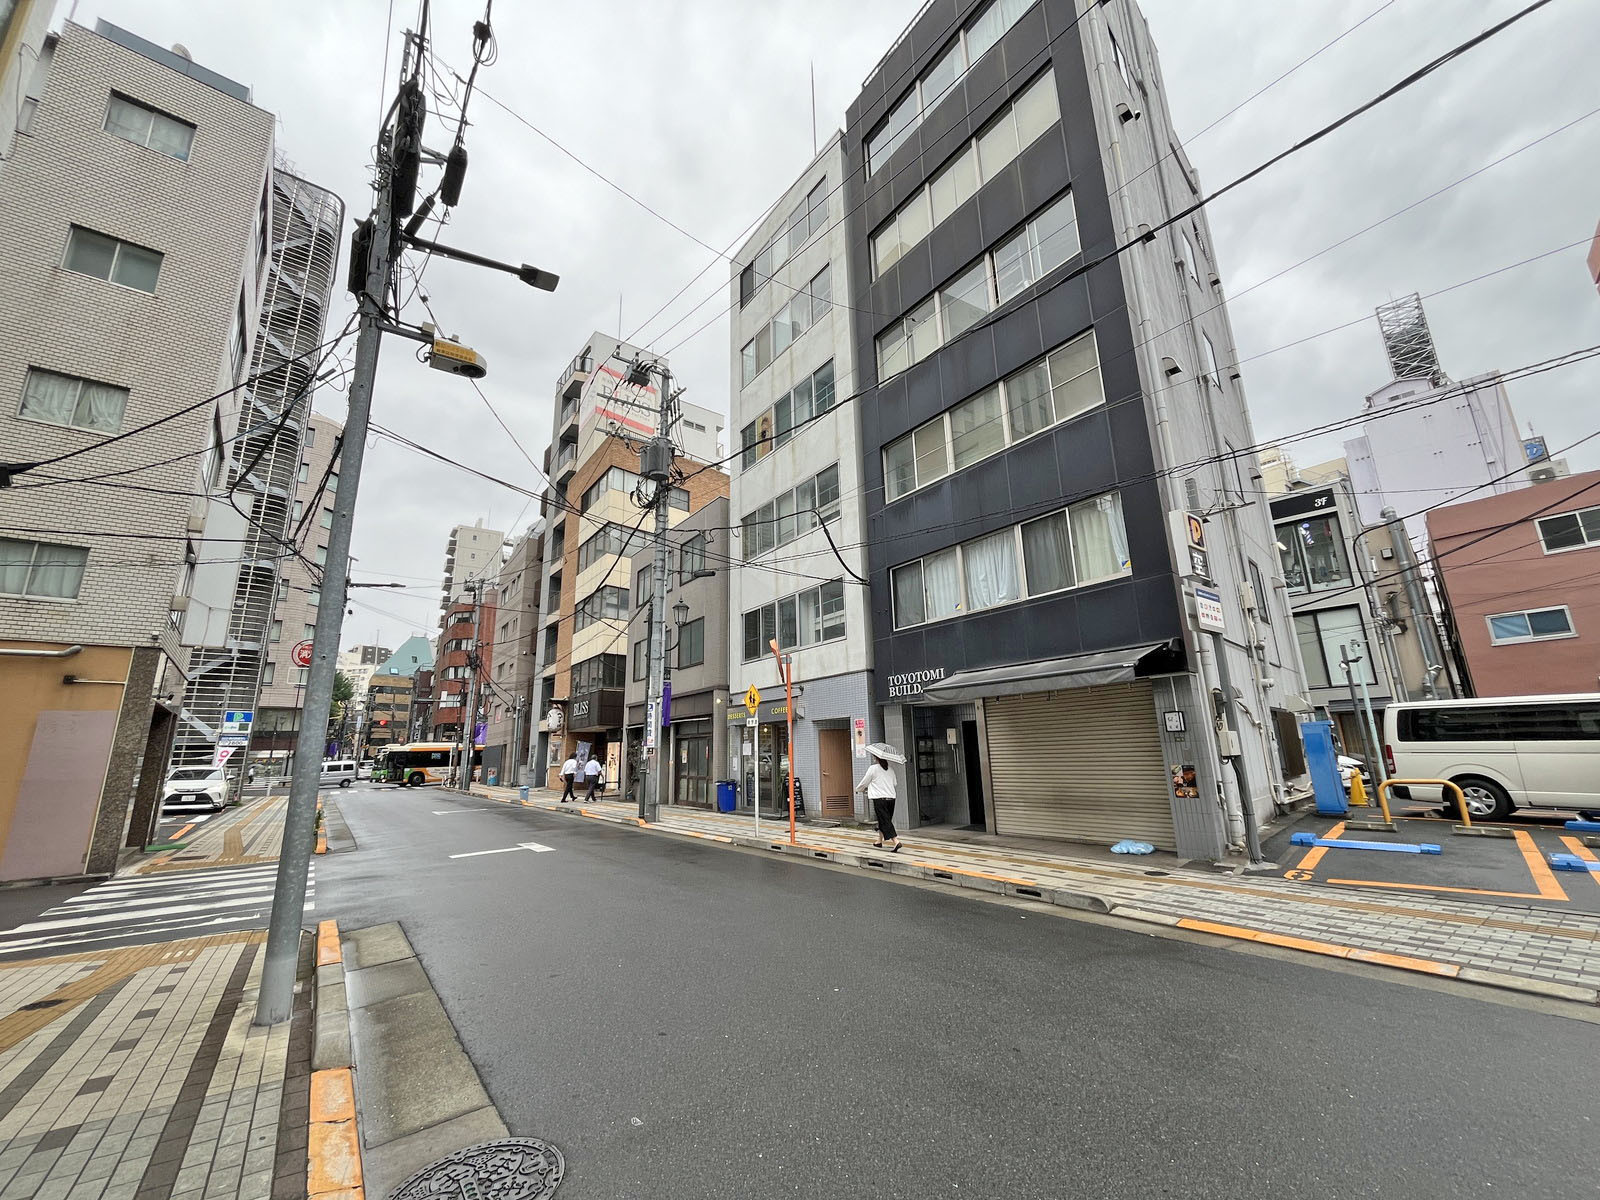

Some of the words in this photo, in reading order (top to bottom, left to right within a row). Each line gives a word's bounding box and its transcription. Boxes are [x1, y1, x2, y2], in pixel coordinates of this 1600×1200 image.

[1314, 496, 1328, 507] 3F
[1190, 519, 1202, 543] P
[888, 667, 945, 686] TOYOTOMI
[889, 683, 924, 697] BUILD.
[573, 698, 589, 716] BLISS
[771, 706, 788, 715] COFFEE
[727, 712, 746, 720] DESSERTS
